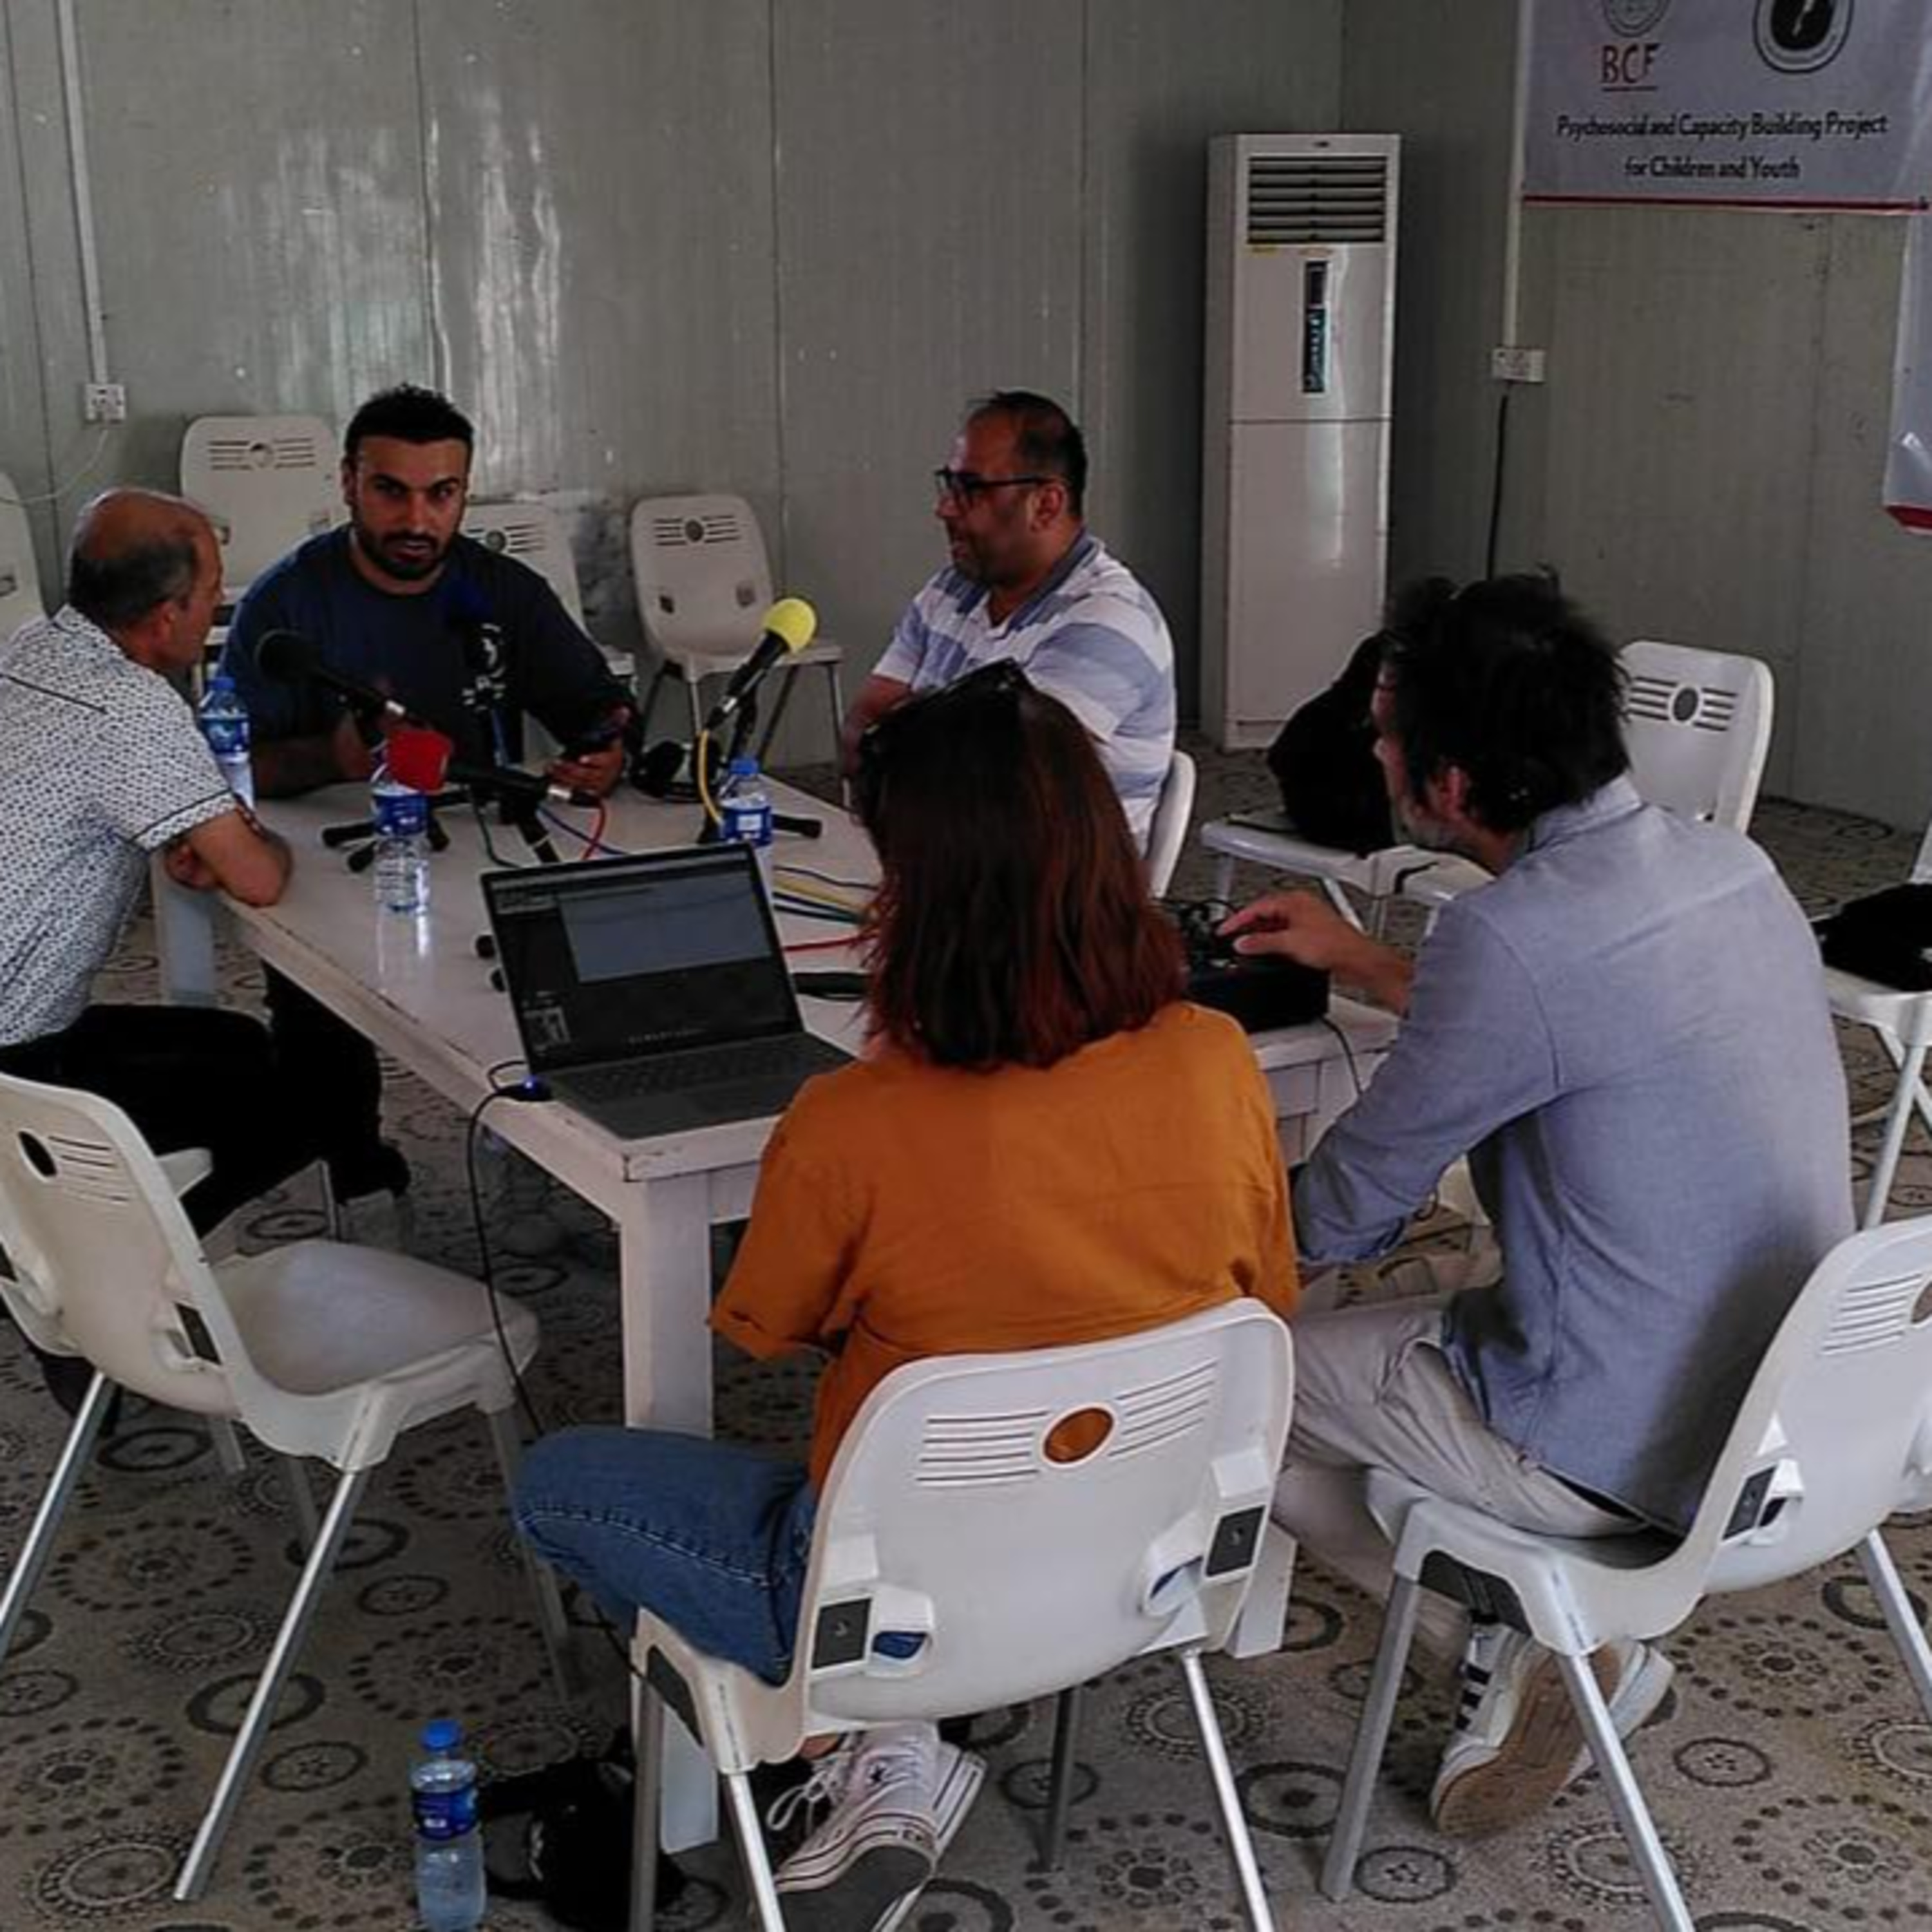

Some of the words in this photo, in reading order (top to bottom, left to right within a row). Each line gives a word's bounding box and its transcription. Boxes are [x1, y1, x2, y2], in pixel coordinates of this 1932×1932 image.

[1600, 43, 1660, 84] BCF
[1650, 114, 1676, 135] and
[1678, 113, 1748, 141] Capacity
[1751, 112, 1822, 140] Building
[1825, 110, 1887, 140] Project
[1625, 155, 1649, 176] for
[1649, 155, 1714, 178] Children
[1718, 155, 1746, 178] and
[1748, 155, 1800, 178] Youth
